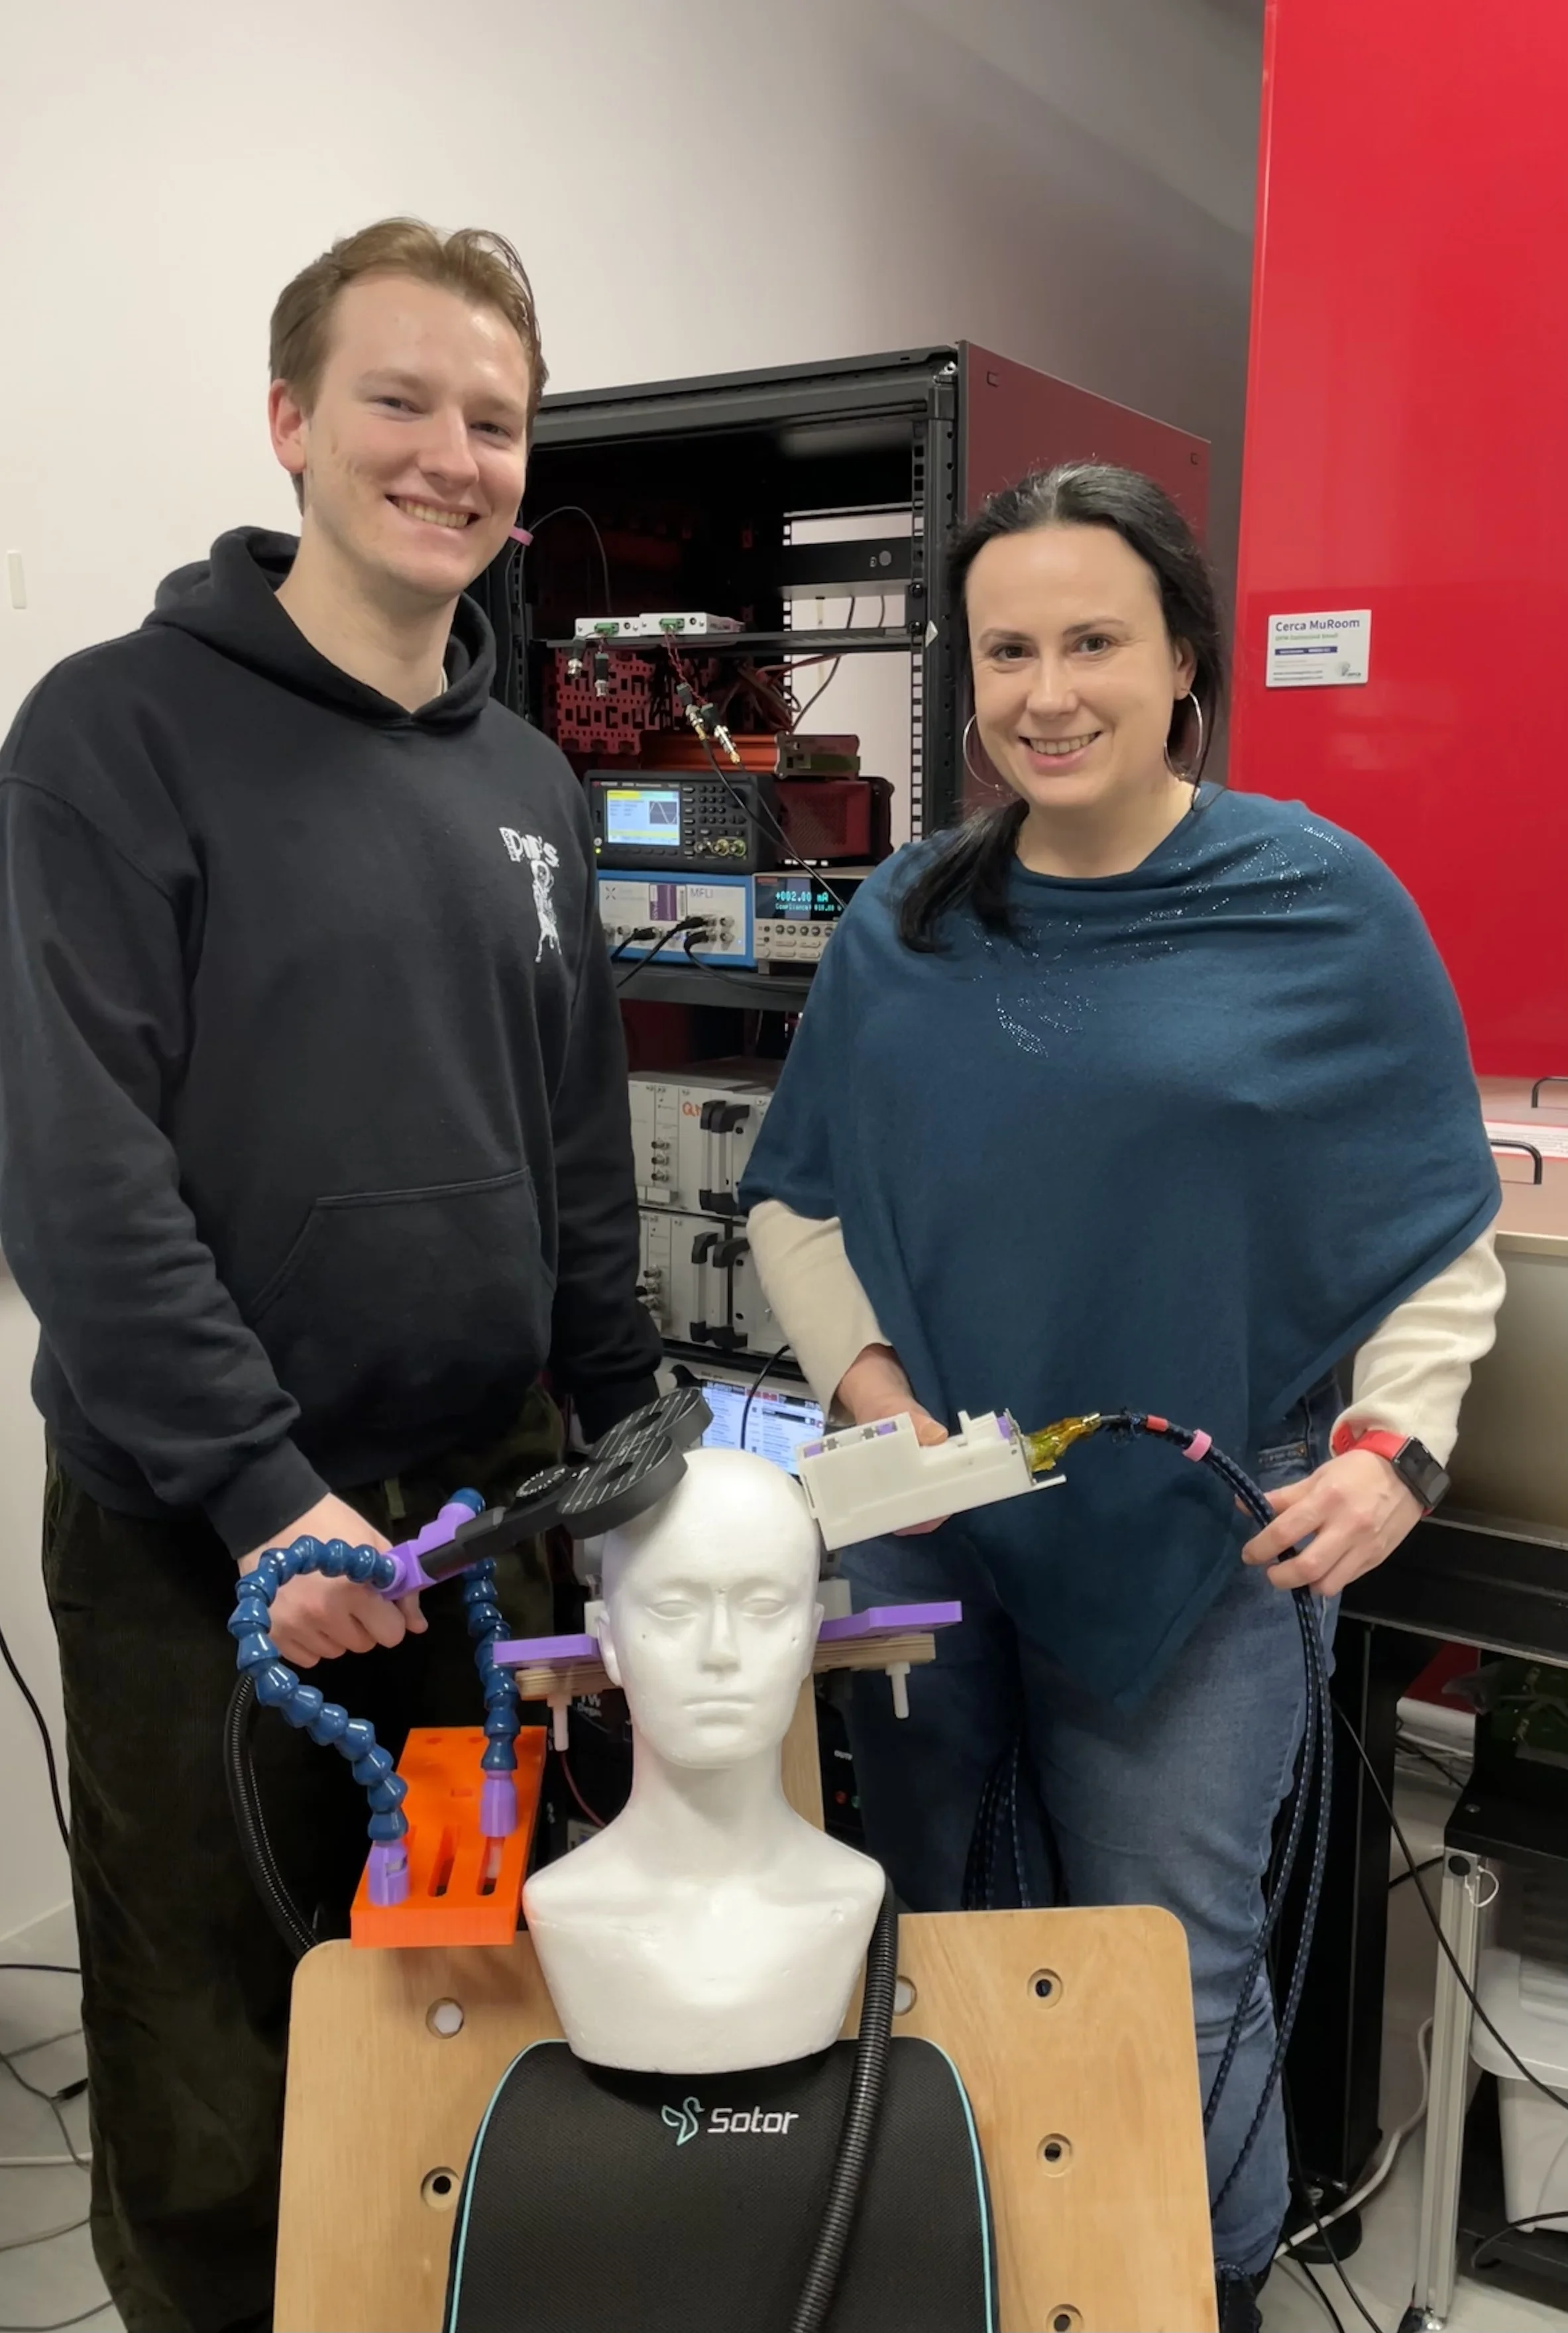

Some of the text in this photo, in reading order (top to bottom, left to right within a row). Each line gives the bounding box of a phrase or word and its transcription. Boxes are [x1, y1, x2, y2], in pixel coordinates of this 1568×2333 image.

[1276, 620, 1360, 632] Cerca MuRoom
[706, 2106, 799, 2135] Sotor
